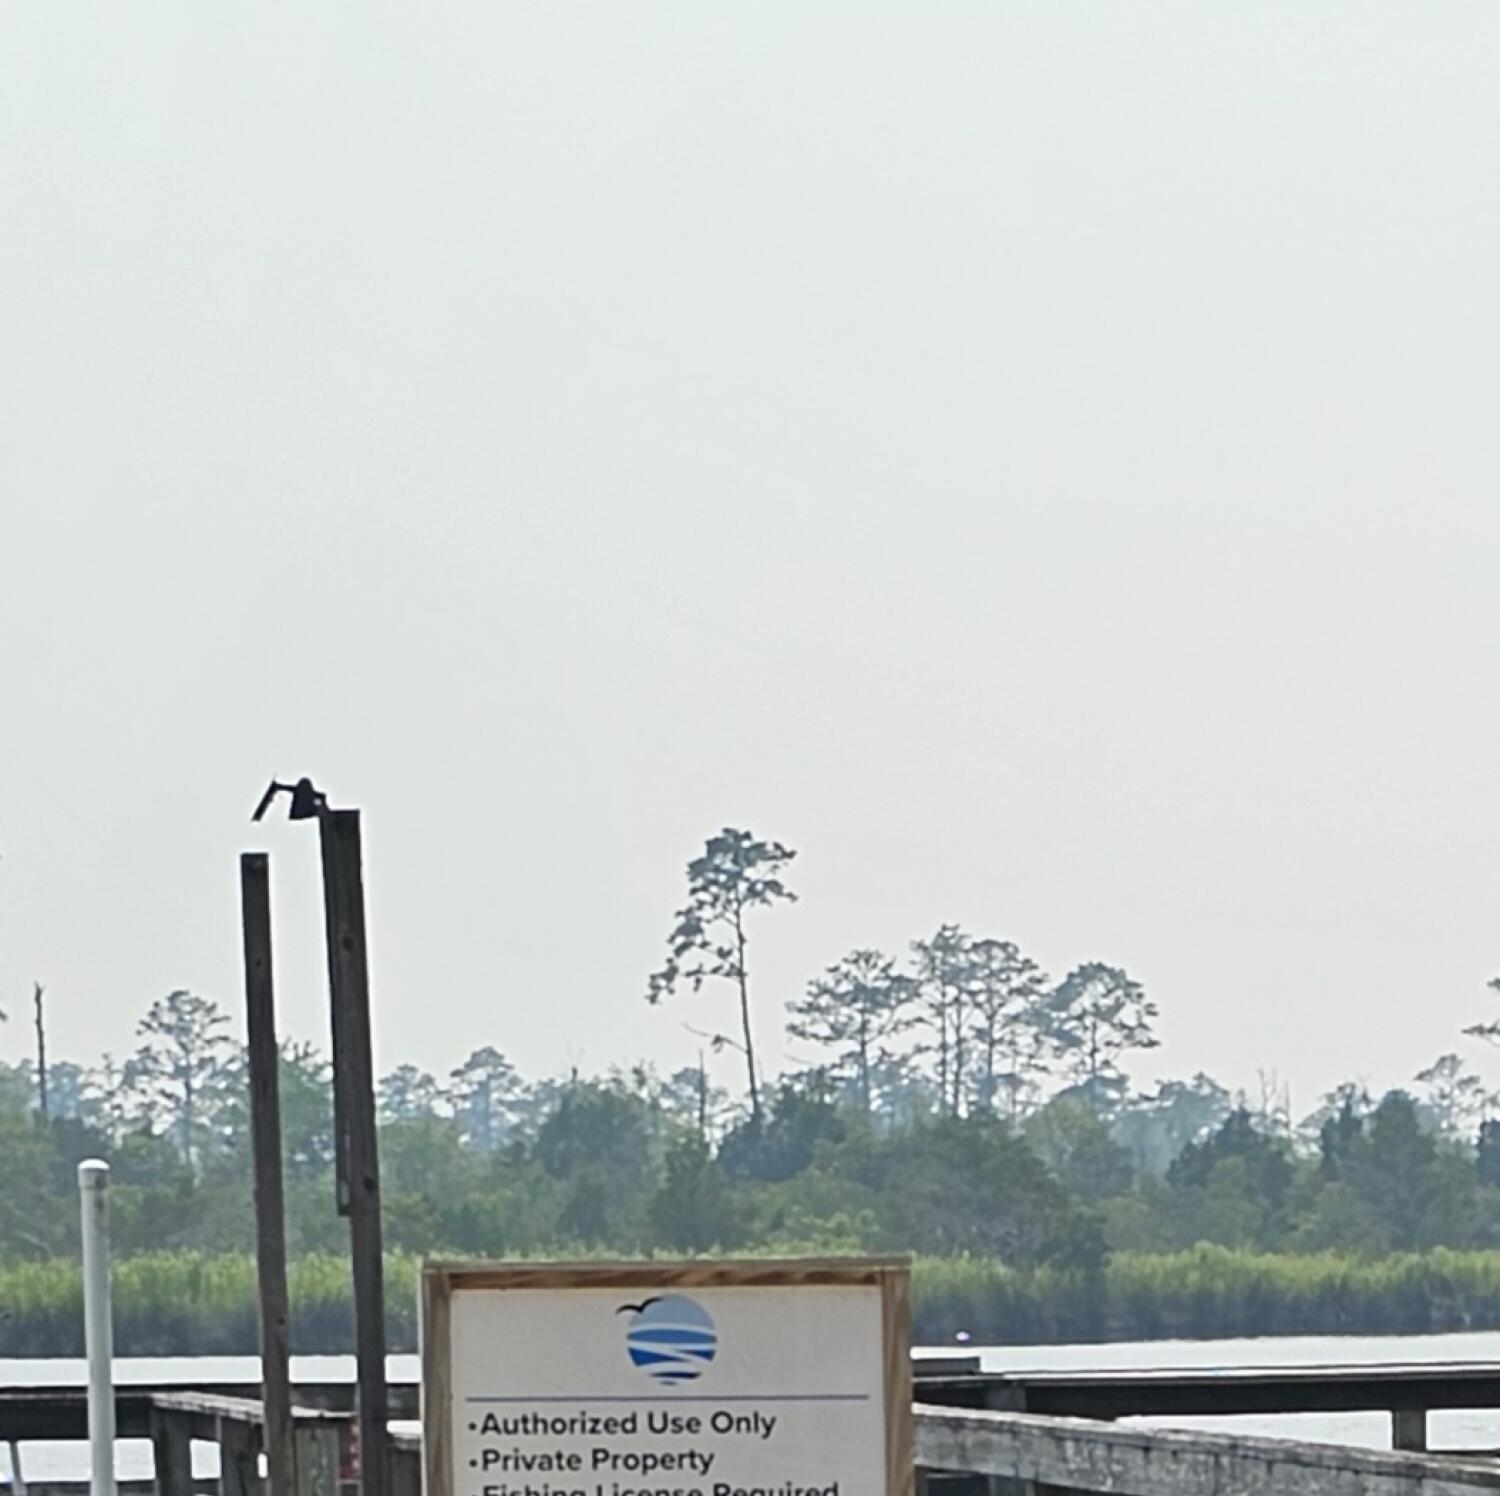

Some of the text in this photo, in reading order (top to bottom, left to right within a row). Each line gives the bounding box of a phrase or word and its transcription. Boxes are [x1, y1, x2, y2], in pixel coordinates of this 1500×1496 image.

[481, 1411, 777, 1438] Authorized Use Only
[482, 1448, 714, 1476] Private Property
